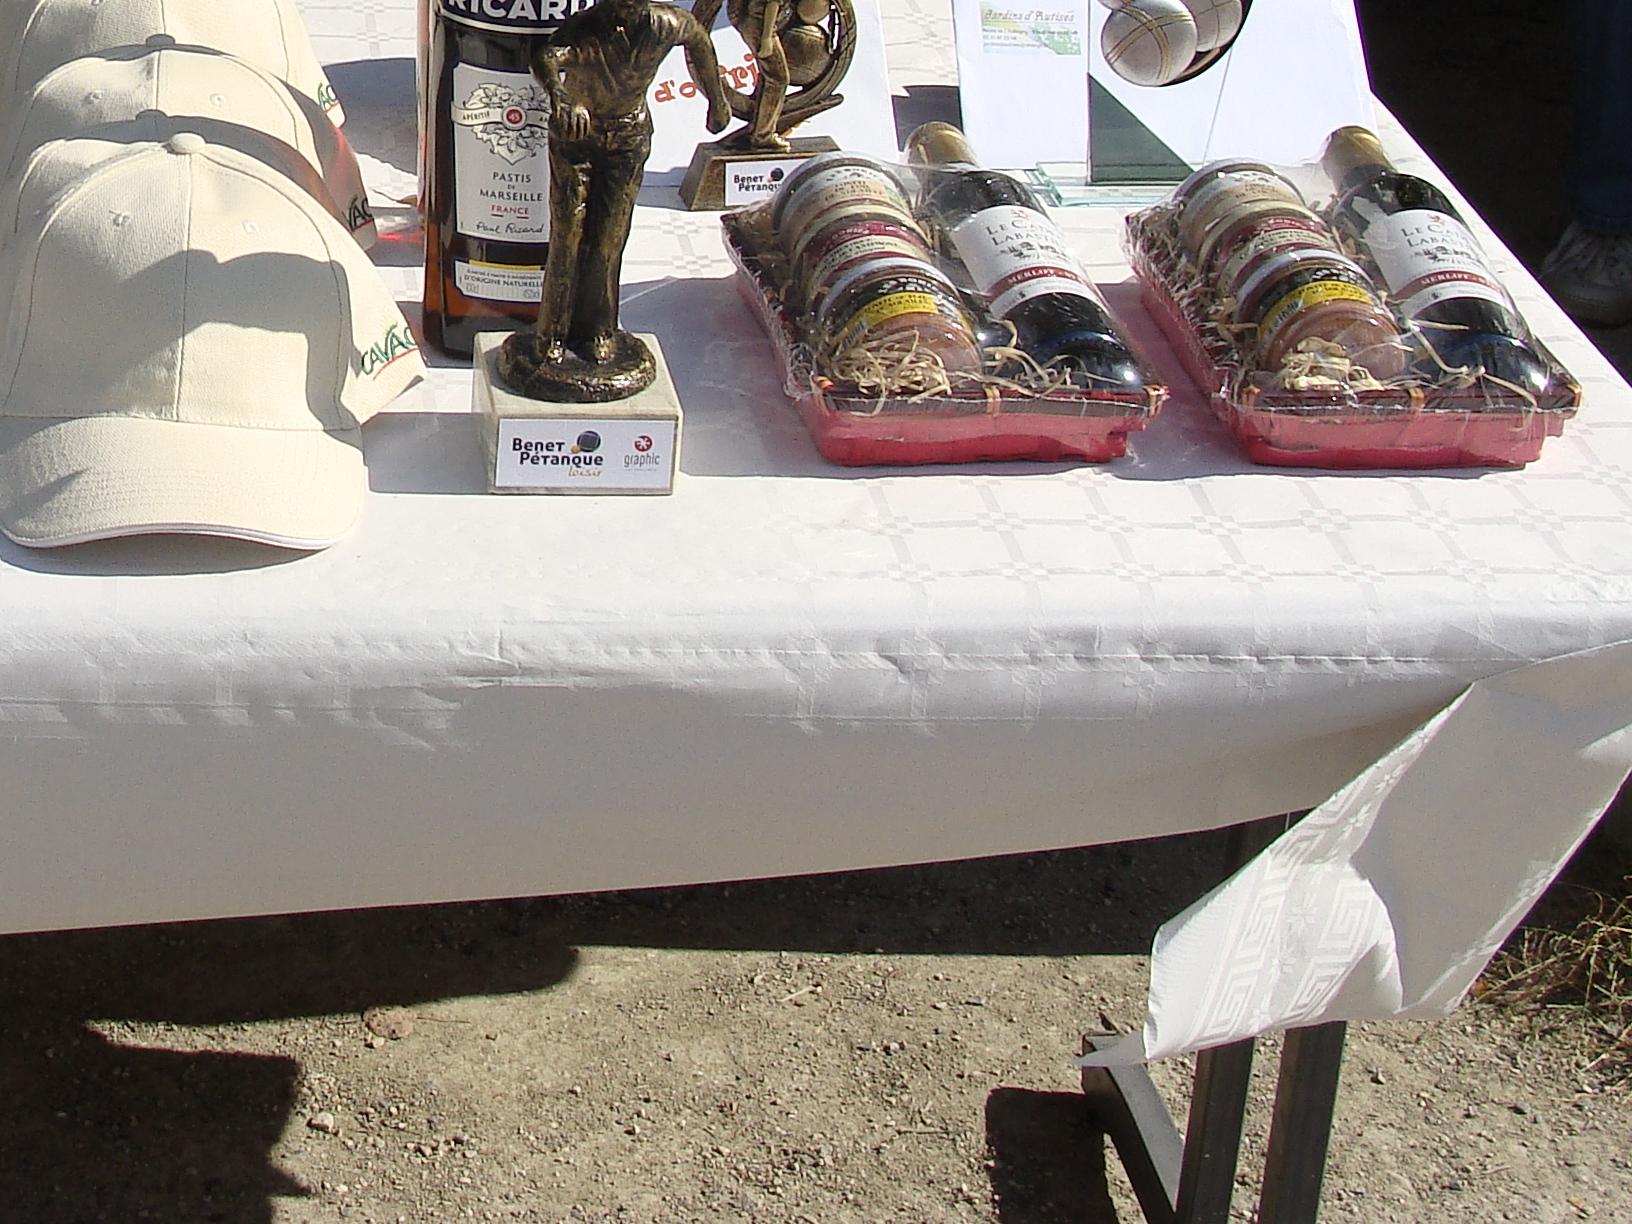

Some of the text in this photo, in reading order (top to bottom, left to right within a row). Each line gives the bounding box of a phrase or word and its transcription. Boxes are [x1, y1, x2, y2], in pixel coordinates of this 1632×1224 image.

[492, 171, 532, 184] PASTIS
[738, 181, 780, 192] Pétanq
[479, 187, 543, 203] MARSEILLE
[491, 204, 530, 215] FRANCE
[475, 221, 500, 235] Paul
[512, 437, 566, 453] Benet
[519, 451, 605, 469] Pétanque
[623, 452, 661, 469] graphic
